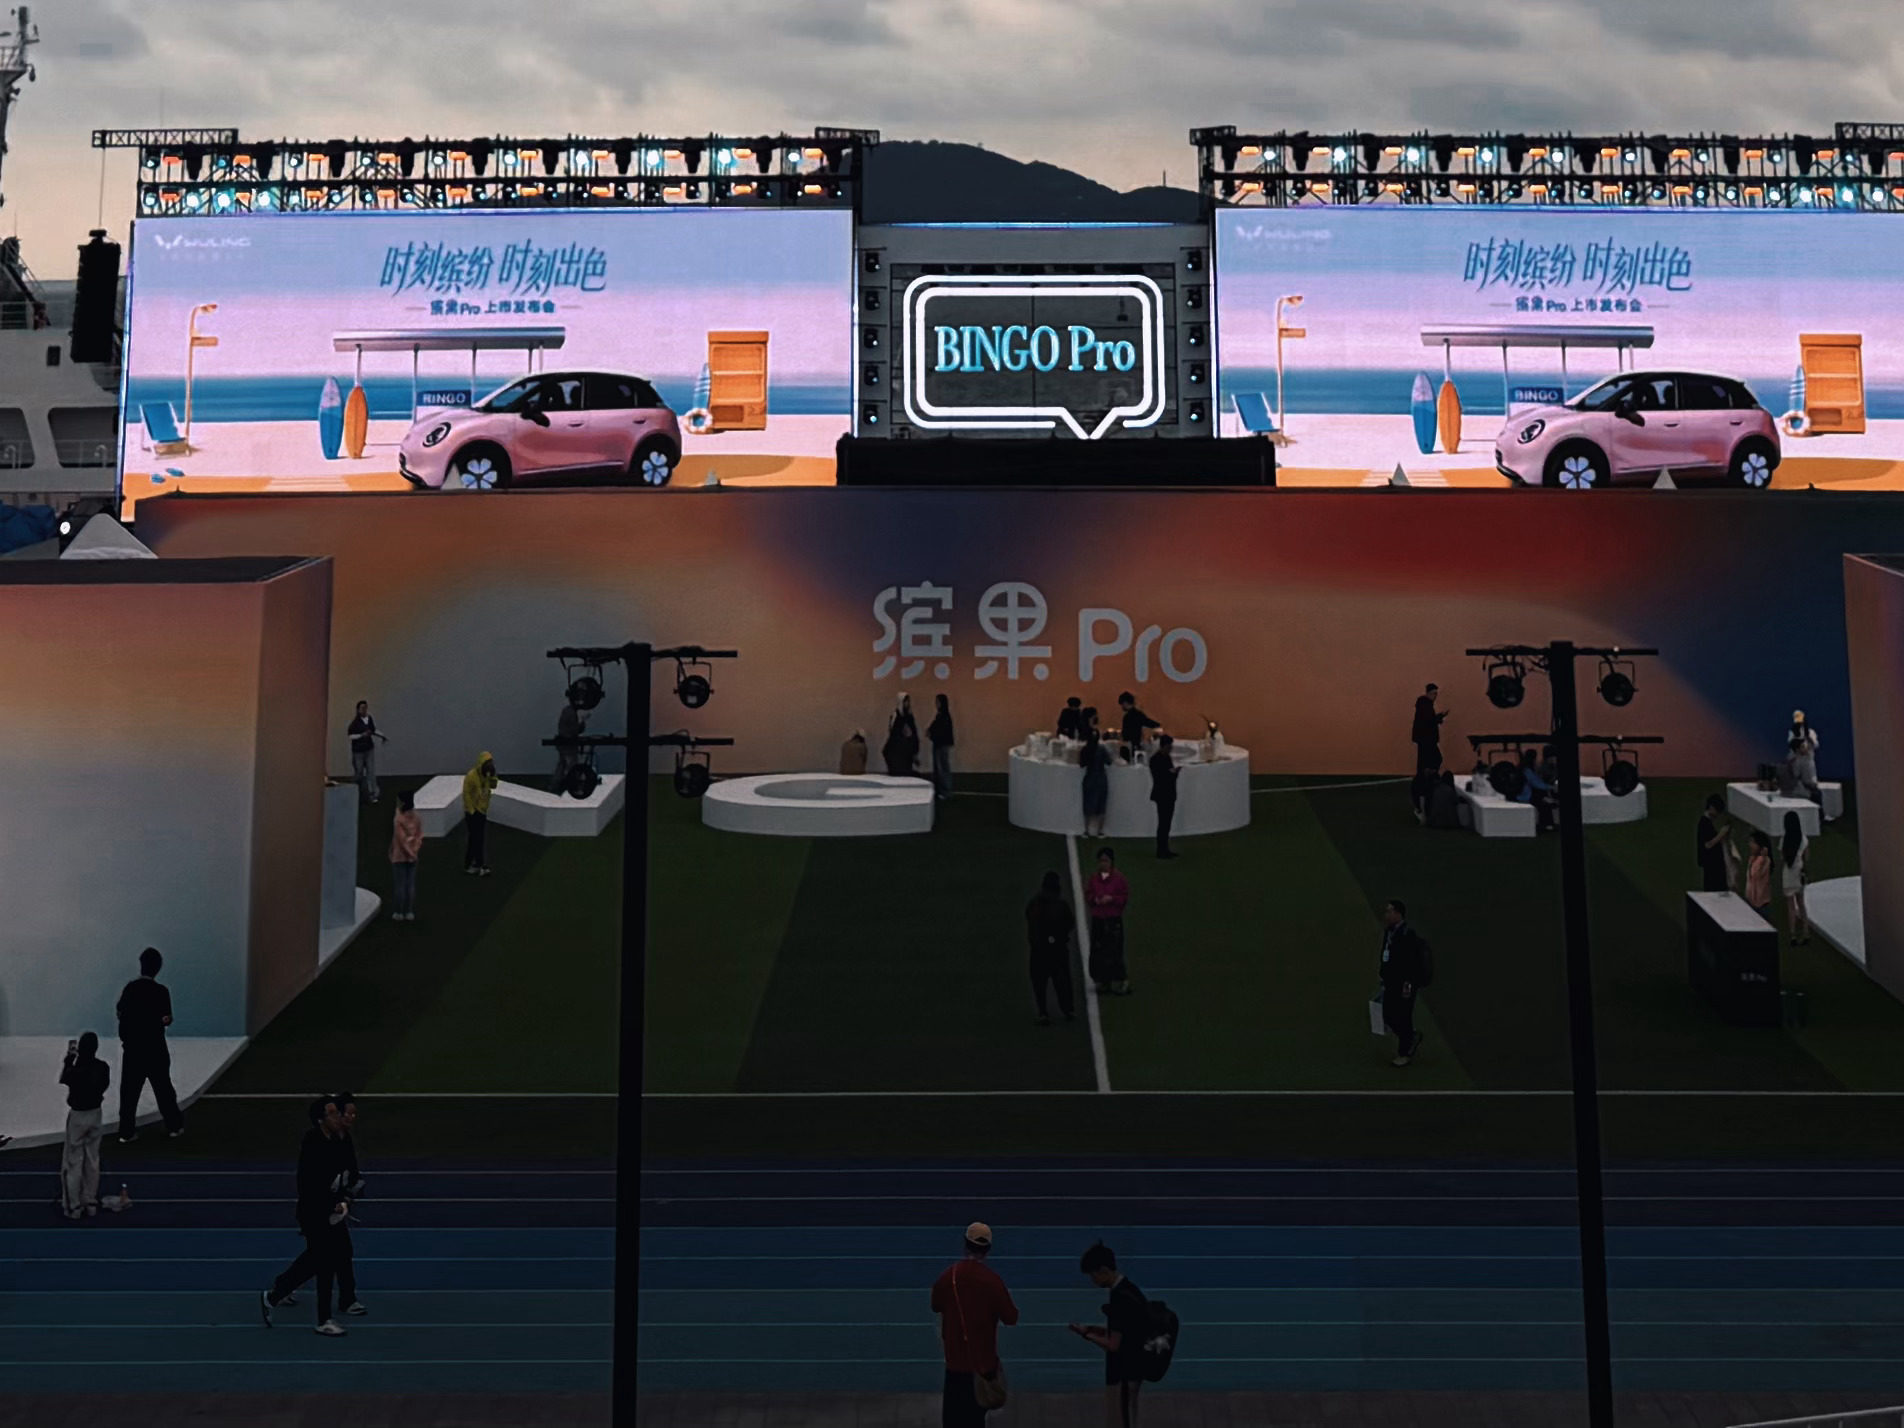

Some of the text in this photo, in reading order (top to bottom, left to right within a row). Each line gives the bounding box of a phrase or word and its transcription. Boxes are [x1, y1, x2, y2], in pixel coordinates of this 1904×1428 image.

[379, 238, 607, 297] 时刻缤纷 时刻出色
[1463, 236, 1693, 294] 时刻缤纷 时刻出色
[934, 325, 1136, 372] BINGO Pro
